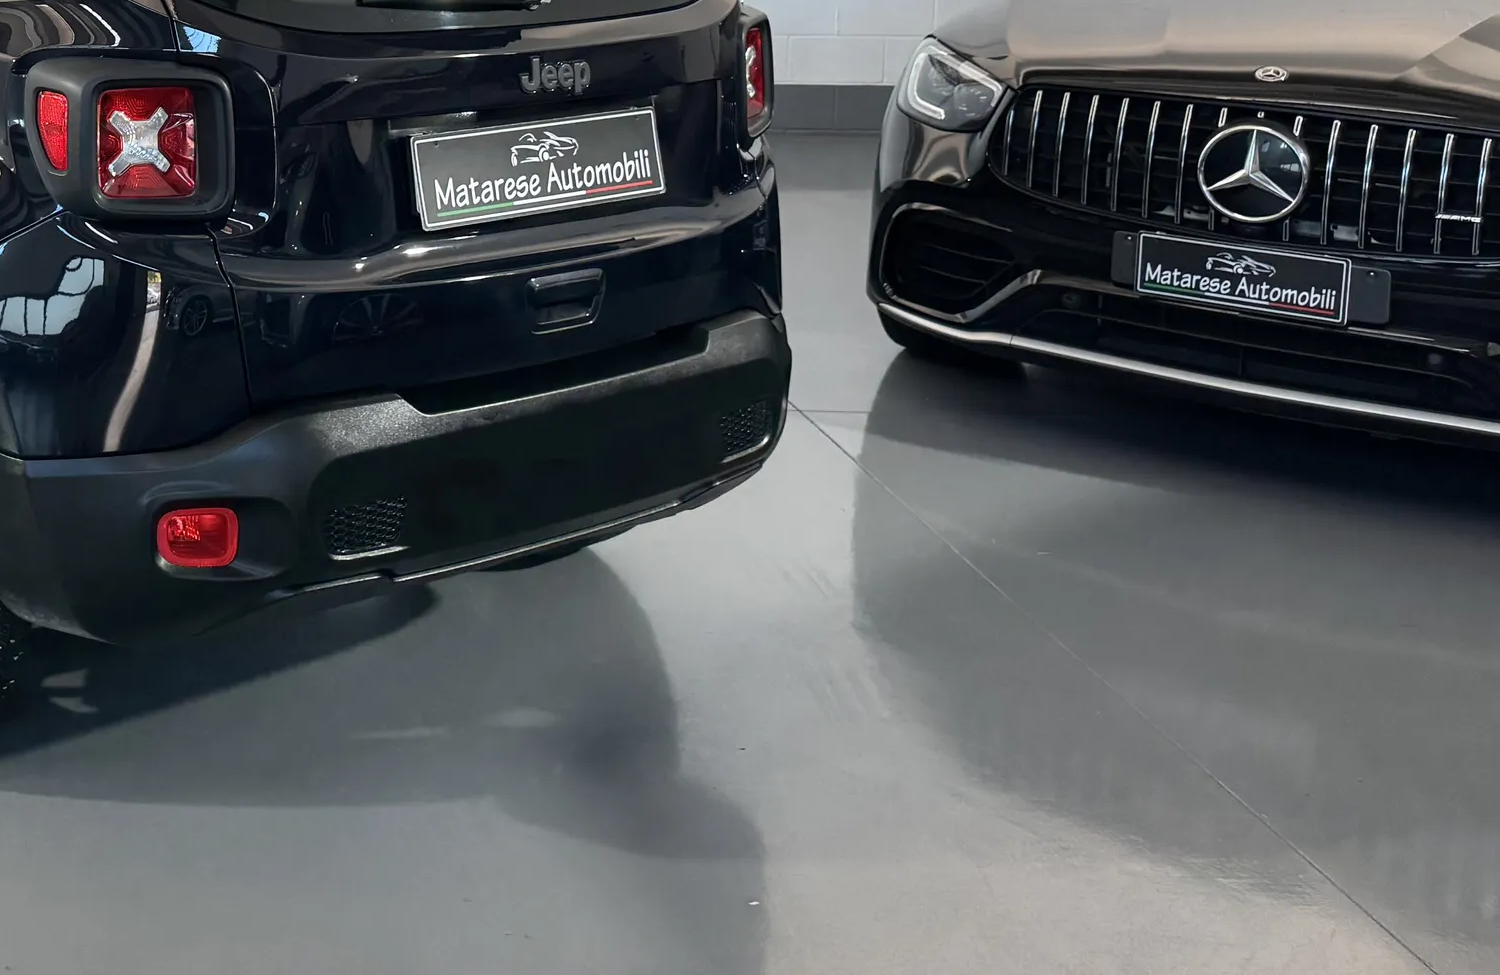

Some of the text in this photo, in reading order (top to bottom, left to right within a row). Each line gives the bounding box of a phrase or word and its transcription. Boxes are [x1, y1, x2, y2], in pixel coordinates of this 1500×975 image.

[520, 57, 591, 95] Jeep
[434, 149, 651, 210] Matarese Automobili
[1145, 262, 1336, 310] Matarese Automobili
